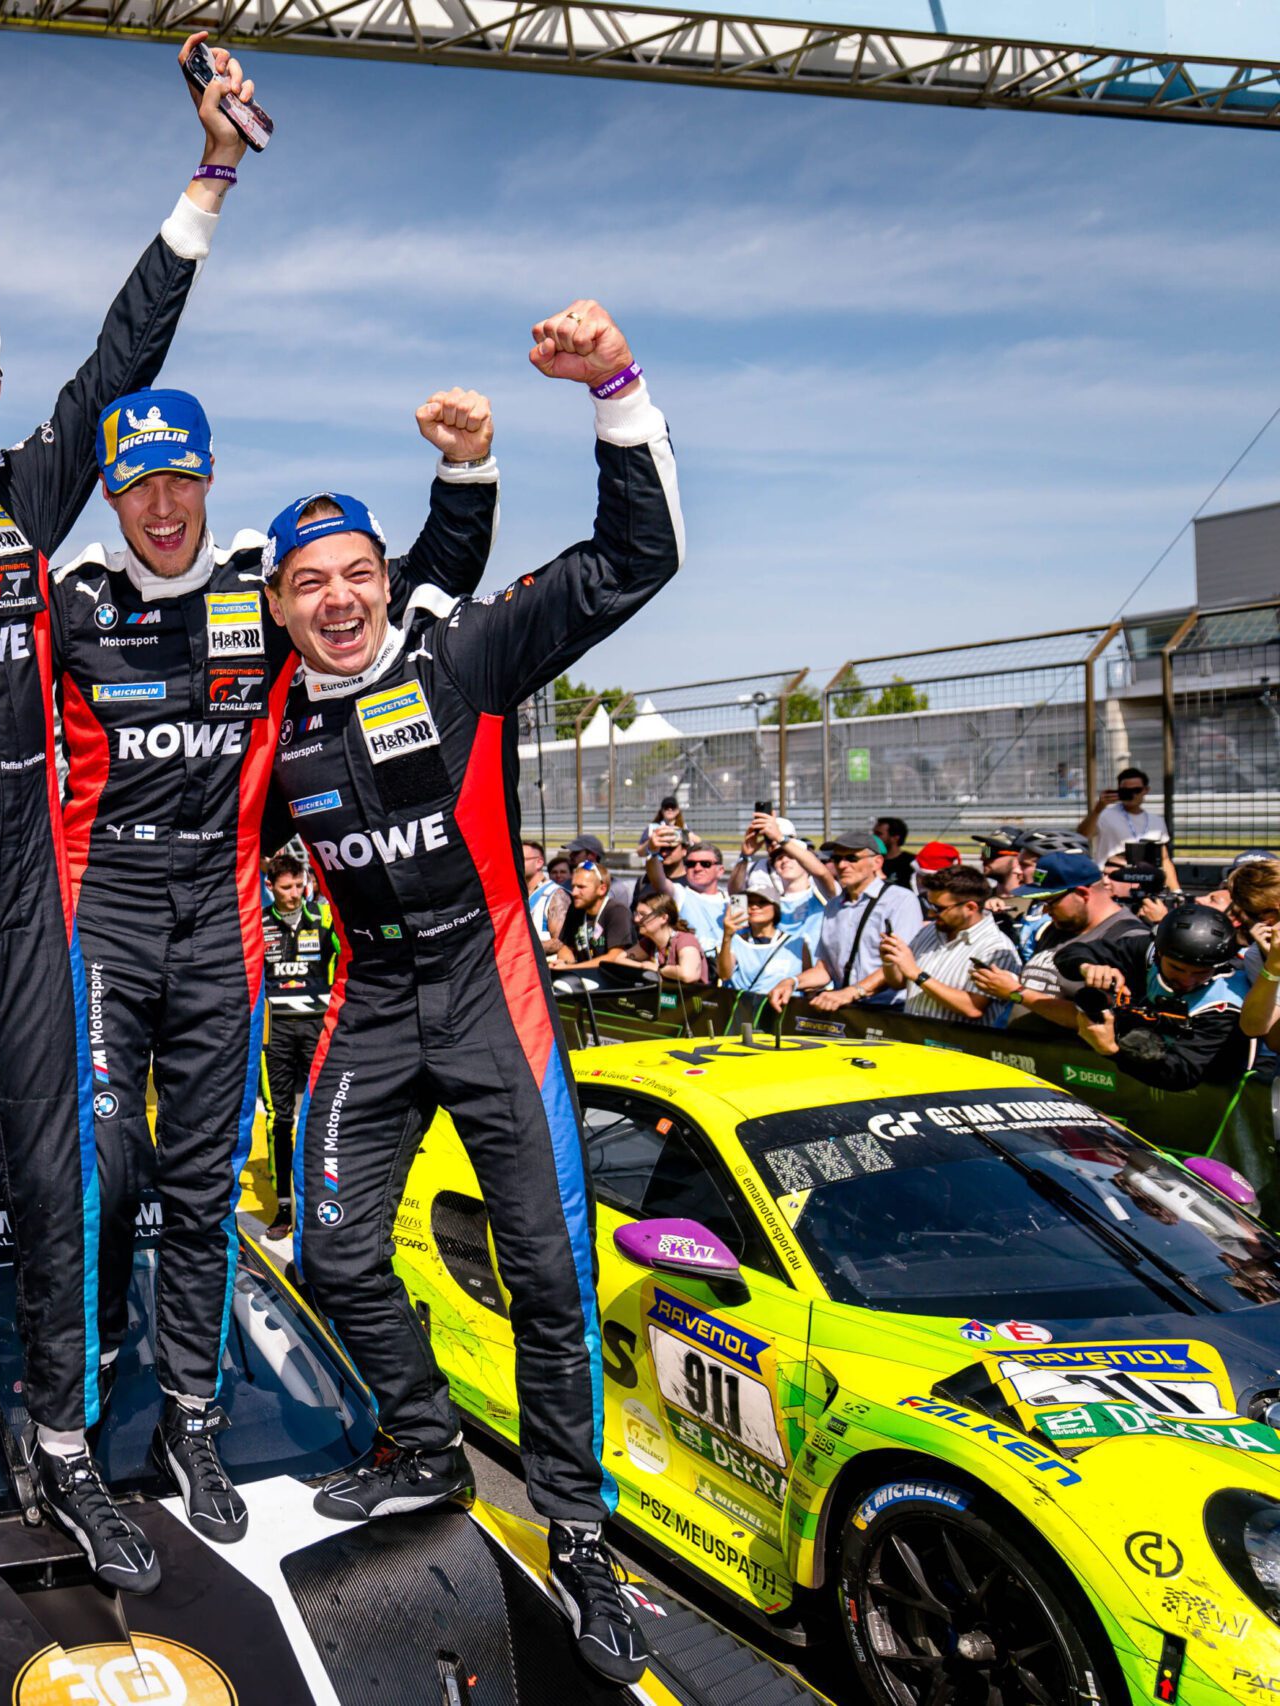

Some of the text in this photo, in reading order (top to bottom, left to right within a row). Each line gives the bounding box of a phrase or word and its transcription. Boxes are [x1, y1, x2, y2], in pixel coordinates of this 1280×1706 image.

[597, 376, 626, 398] Driver
[118, 431, 189, 454] MICHELIN
[299, 520, 345, 536] MOTORSPORT
[214, 604, 254, 613] RAVENOL
[99, 635, 159, 647] Motorsport
[112, 687, 159, 697] MICHELIN
[320, 676, 364, 692] Eurobike
[221, 702, 262, 711] CHALLENGE
[365, 695, 415, 717] RAVENOL
[114, 721, 245, 760] ROWE
[281, 742, 323, 763] Motorsport
[297, 796, 334, 811] MICHELIN
[177, 830, 224, 840] Jesse Krohn
[312, 812, 449, 872] ROWE
[417, 922, 453, 938] Augusto
[90, 962, 105, 1045] Motorsport
[799, 1020, 841, 1034] RAVENOL
[1080, 1071, 1114, 1087] DEKRA
[324, 1071, 355, 1151] Motorsport
[925, 1100, 1099, 1127] GRAN TURISMO
[978, 1121, 1011, 1132] REAL
[658, 1300, 753, 1362] RAVENOL
[1010, 1349, 1187, 1366] RAVENOL
[684, 1350, 742, 1437] 911
[1051, 1426, 1097, 1436] nürburgring
[1103, 1404, 1276, 1452] DEKRA
[636, 1441, 665, 1464] CHALLENGE
[812, 1431, 835, 1453] BBS
[897, 1396, 1082, 1487] FALKEN
[874, 1483, 961, 1506] MICHELIN
[714, 1492, 779, 1538] MICHELIN
[640, 1490, 776, 1596] PSZ MEUSPATH
